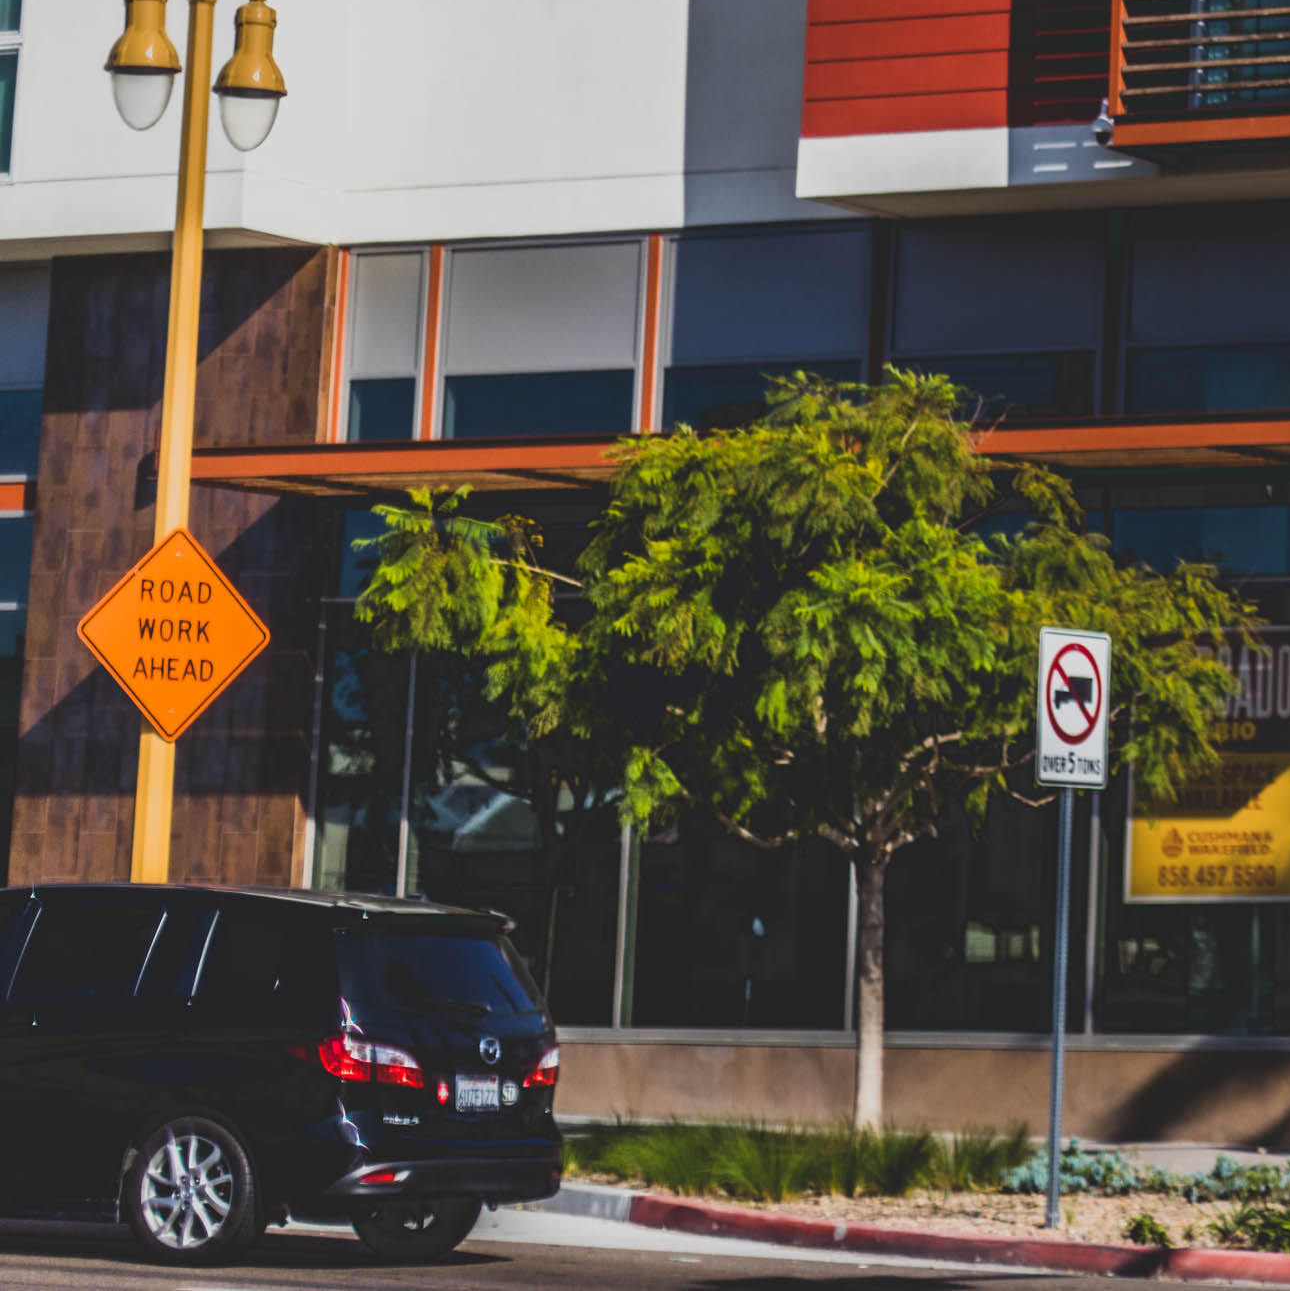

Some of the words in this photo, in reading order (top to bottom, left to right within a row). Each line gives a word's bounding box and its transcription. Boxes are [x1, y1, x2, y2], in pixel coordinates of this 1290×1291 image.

[141, 579, 212, 604] ROAD
[139, 618, 210, 643] WORK
[133, 657, 213, 682] AHEAD
[1041, 755, 1066, 773] OVER
[1068, 751, 1076, 774] 5
[1078, 757, 1101, 775] TONS
